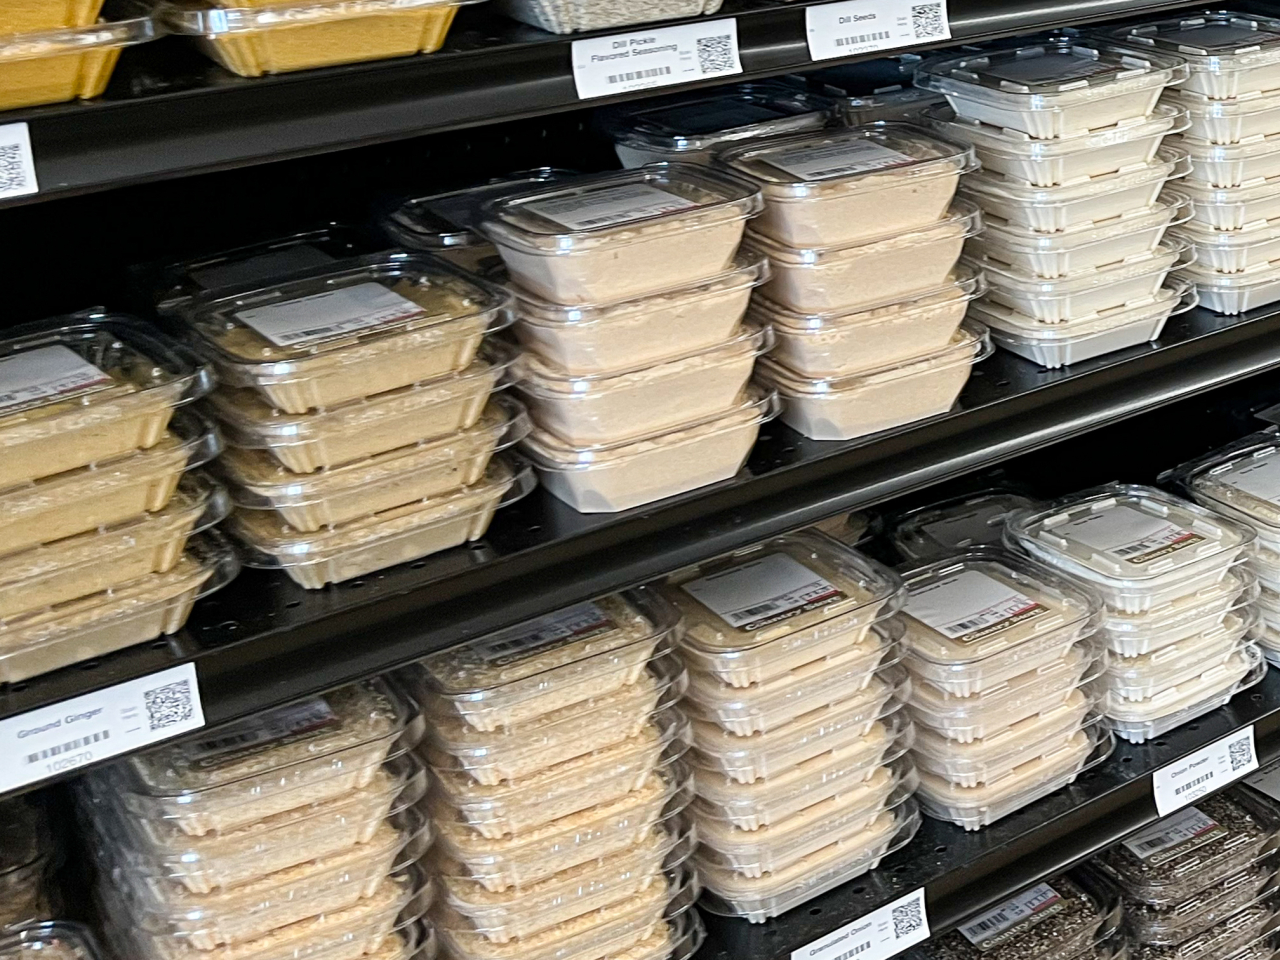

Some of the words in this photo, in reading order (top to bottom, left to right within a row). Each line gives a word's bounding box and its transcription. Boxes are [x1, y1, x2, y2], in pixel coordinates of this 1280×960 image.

[838, 16, 852, 25] Dill
[853, 13, 876, 23] Seeds
[591, 49, 630, 63] Flavored
[632, 43, 678, 58] Seasoning
[613, 39, 627, 50] Dill
[629, 36, 657, 48] Pickle
[745, 608, 802, 631] Country
[803, 595, 842, 611] Store
[962, 621, 1010, 642] Country
[17, 719, 62, 740] Ground
[64, 707, 104, 727] Ginger
[1170, 767, 1187, 779] Onion
[1187, 756, 1210, 772] Powder
[1149, 841, 1192, 864] Country
[1193, 828, 1223, 844] Store
[808, 932, 849, 957] Granulated
[850, 920, 873, 938] Onion
[982, 921, 1031, 949] Country
[1030, 902, 1064, 922] Store
